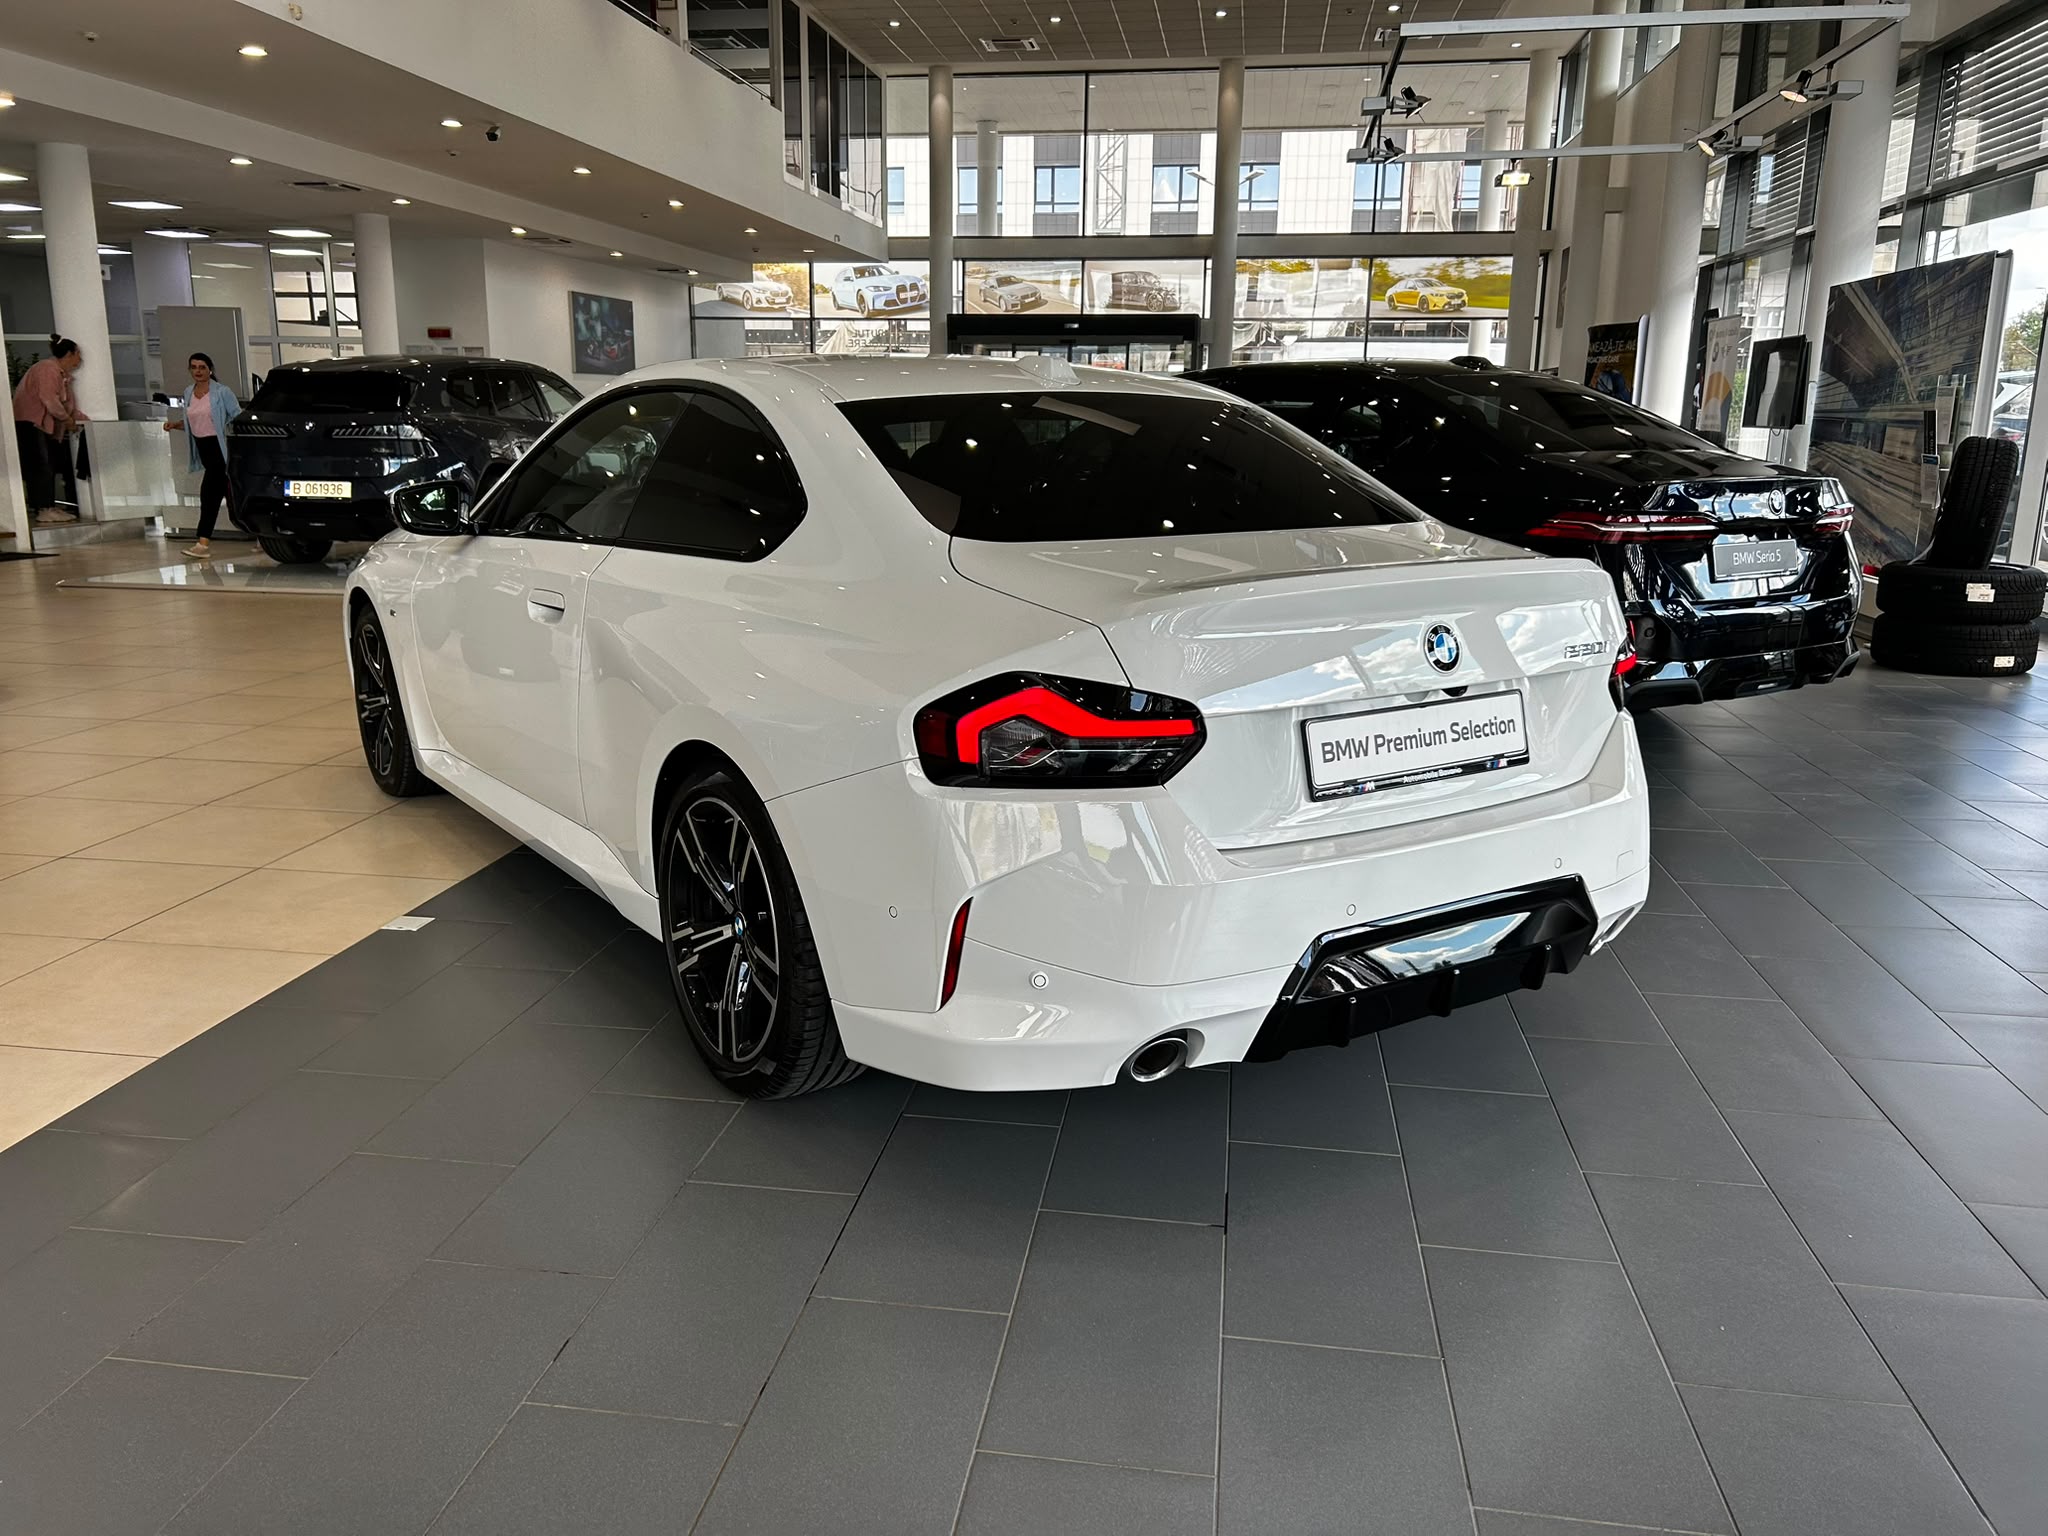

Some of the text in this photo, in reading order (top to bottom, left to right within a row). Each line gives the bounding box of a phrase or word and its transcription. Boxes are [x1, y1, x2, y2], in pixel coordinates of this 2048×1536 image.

[293, 483, 343, 495] B 061936
[1733, 552, 1755, 565] BMW
[1776, 549, 1781, 562] 5
[1321, 716, 1516, 764] BMW Premium Selection
